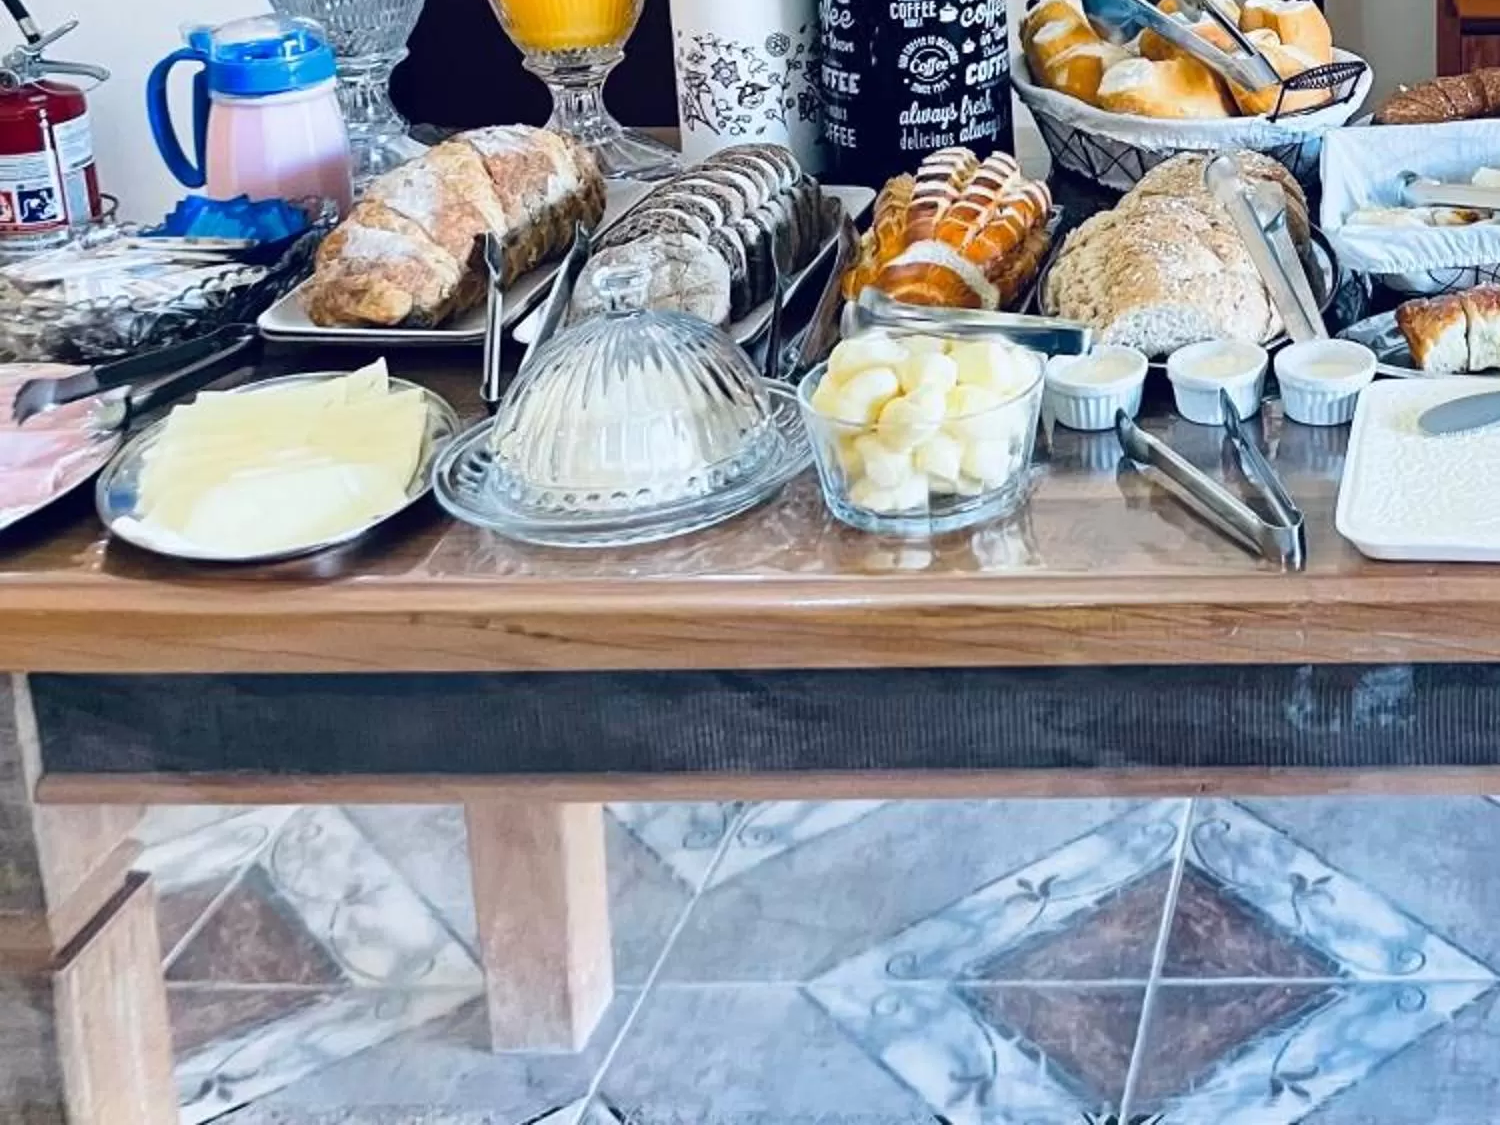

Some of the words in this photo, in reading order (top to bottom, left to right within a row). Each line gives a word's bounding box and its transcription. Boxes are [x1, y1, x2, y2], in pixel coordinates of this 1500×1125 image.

[890, 0, 936, 19] COFFEE
[909, 56, 949, 77] Coffee
[899, 100, 958, 130] always
[900, 127, 955, 150] delicious
